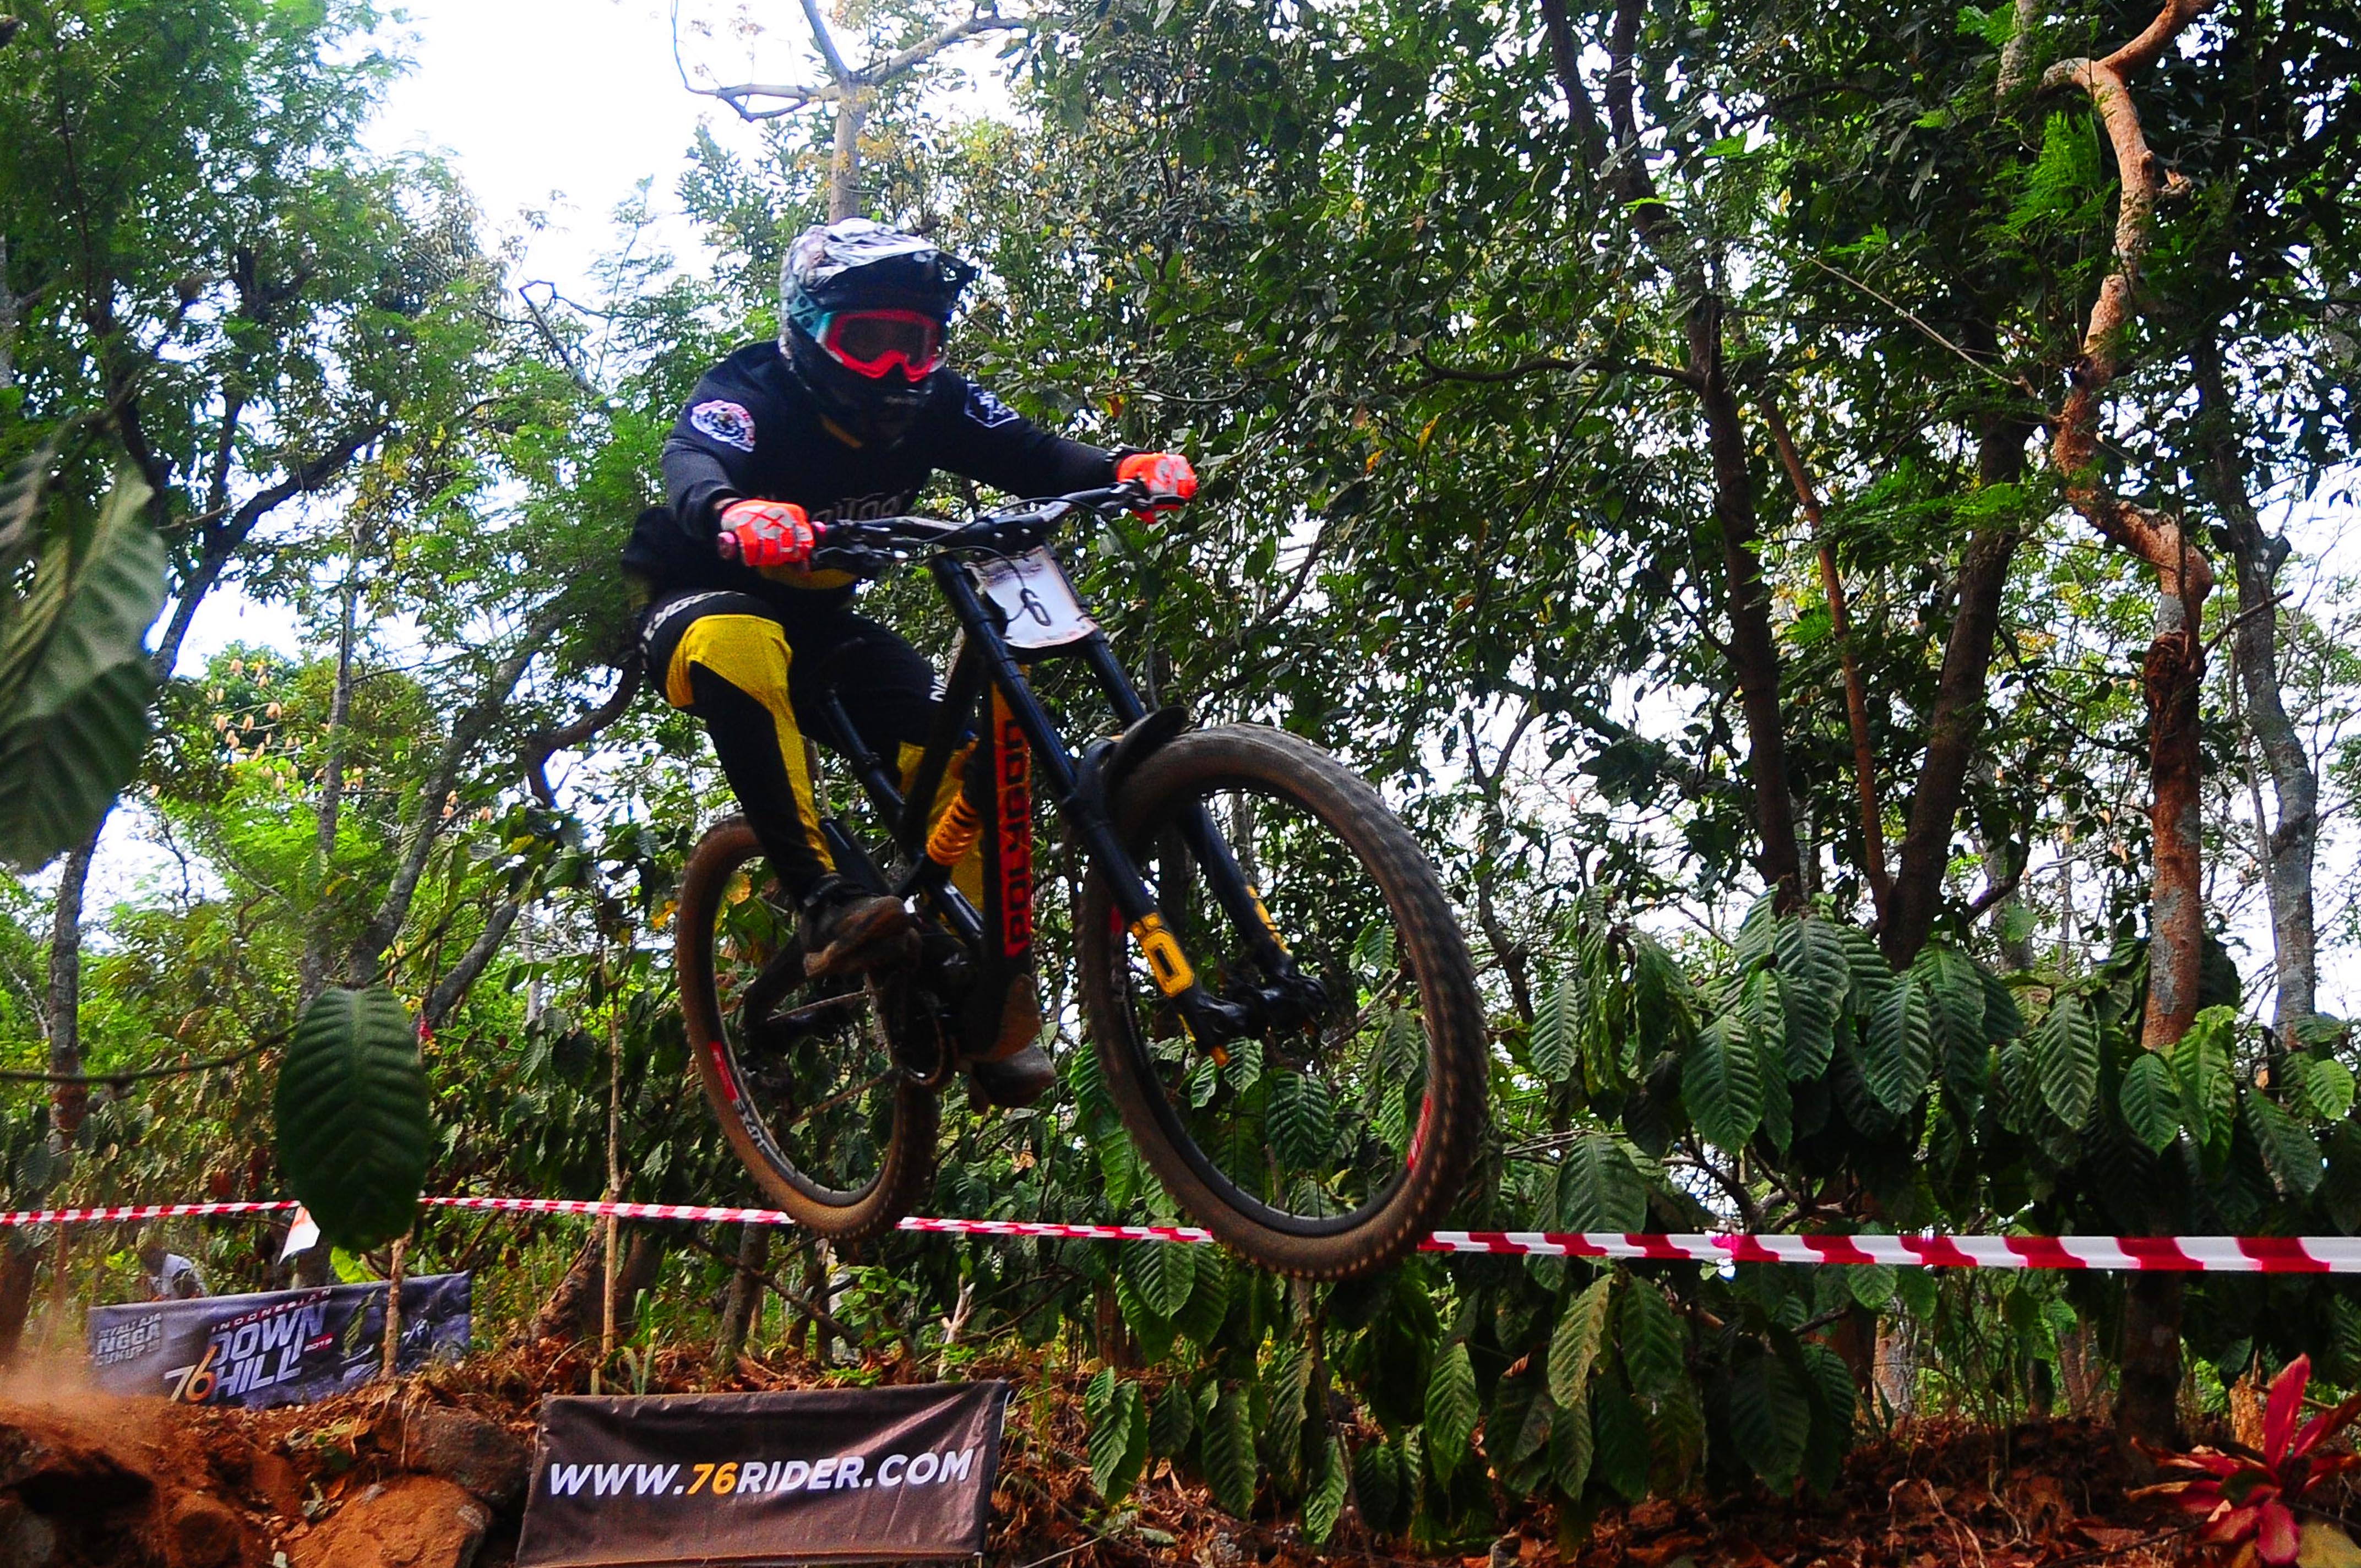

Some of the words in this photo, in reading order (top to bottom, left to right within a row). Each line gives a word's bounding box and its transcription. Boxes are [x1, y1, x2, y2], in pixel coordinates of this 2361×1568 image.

[209, 1300, 330, 1368] DOWN
[211, 1288, 331, 1333] INDONESIAN
[97, 1322, 161, 1355] NGGA
[165, 1344, 217, 1402] 76
[214, 1345, 302, 1401] HILL
[551, 1448, 975, 1496] WWW.76RIDER.COM
